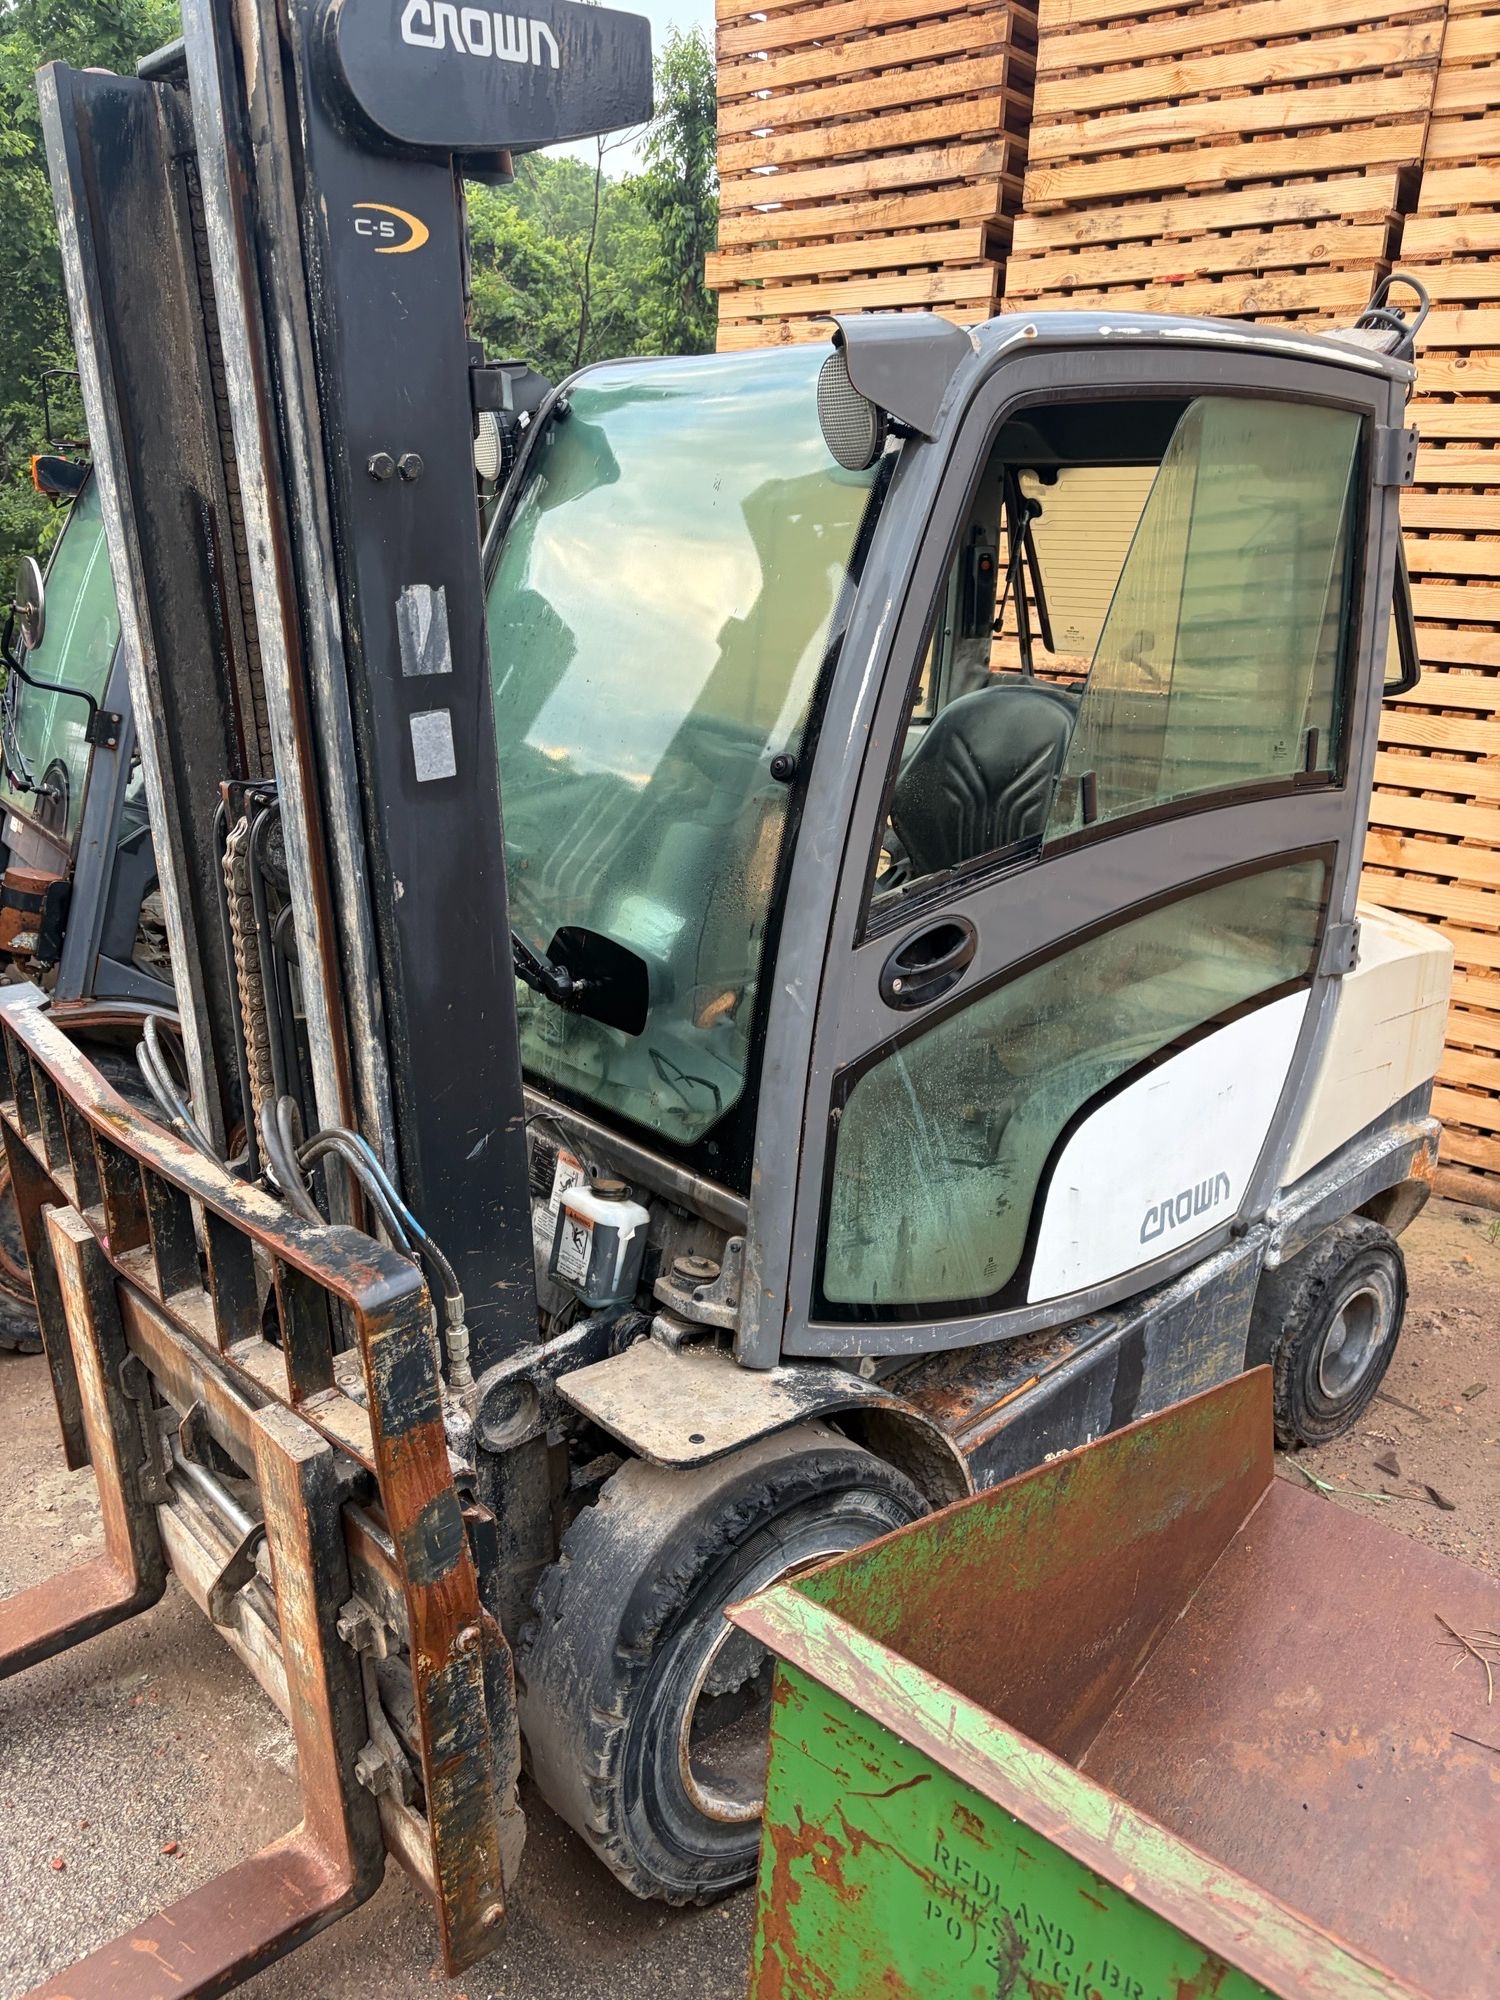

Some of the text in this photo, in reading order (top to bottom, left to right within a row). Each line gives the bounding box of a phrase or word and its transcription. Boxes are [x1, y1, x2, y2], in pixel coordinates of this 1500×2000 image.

[401, 0, 560, 69] CROWN
[1140, 1170, 1231, 1245] CROWN
[933, 1841, 1162, 2000] REDLAND BR
